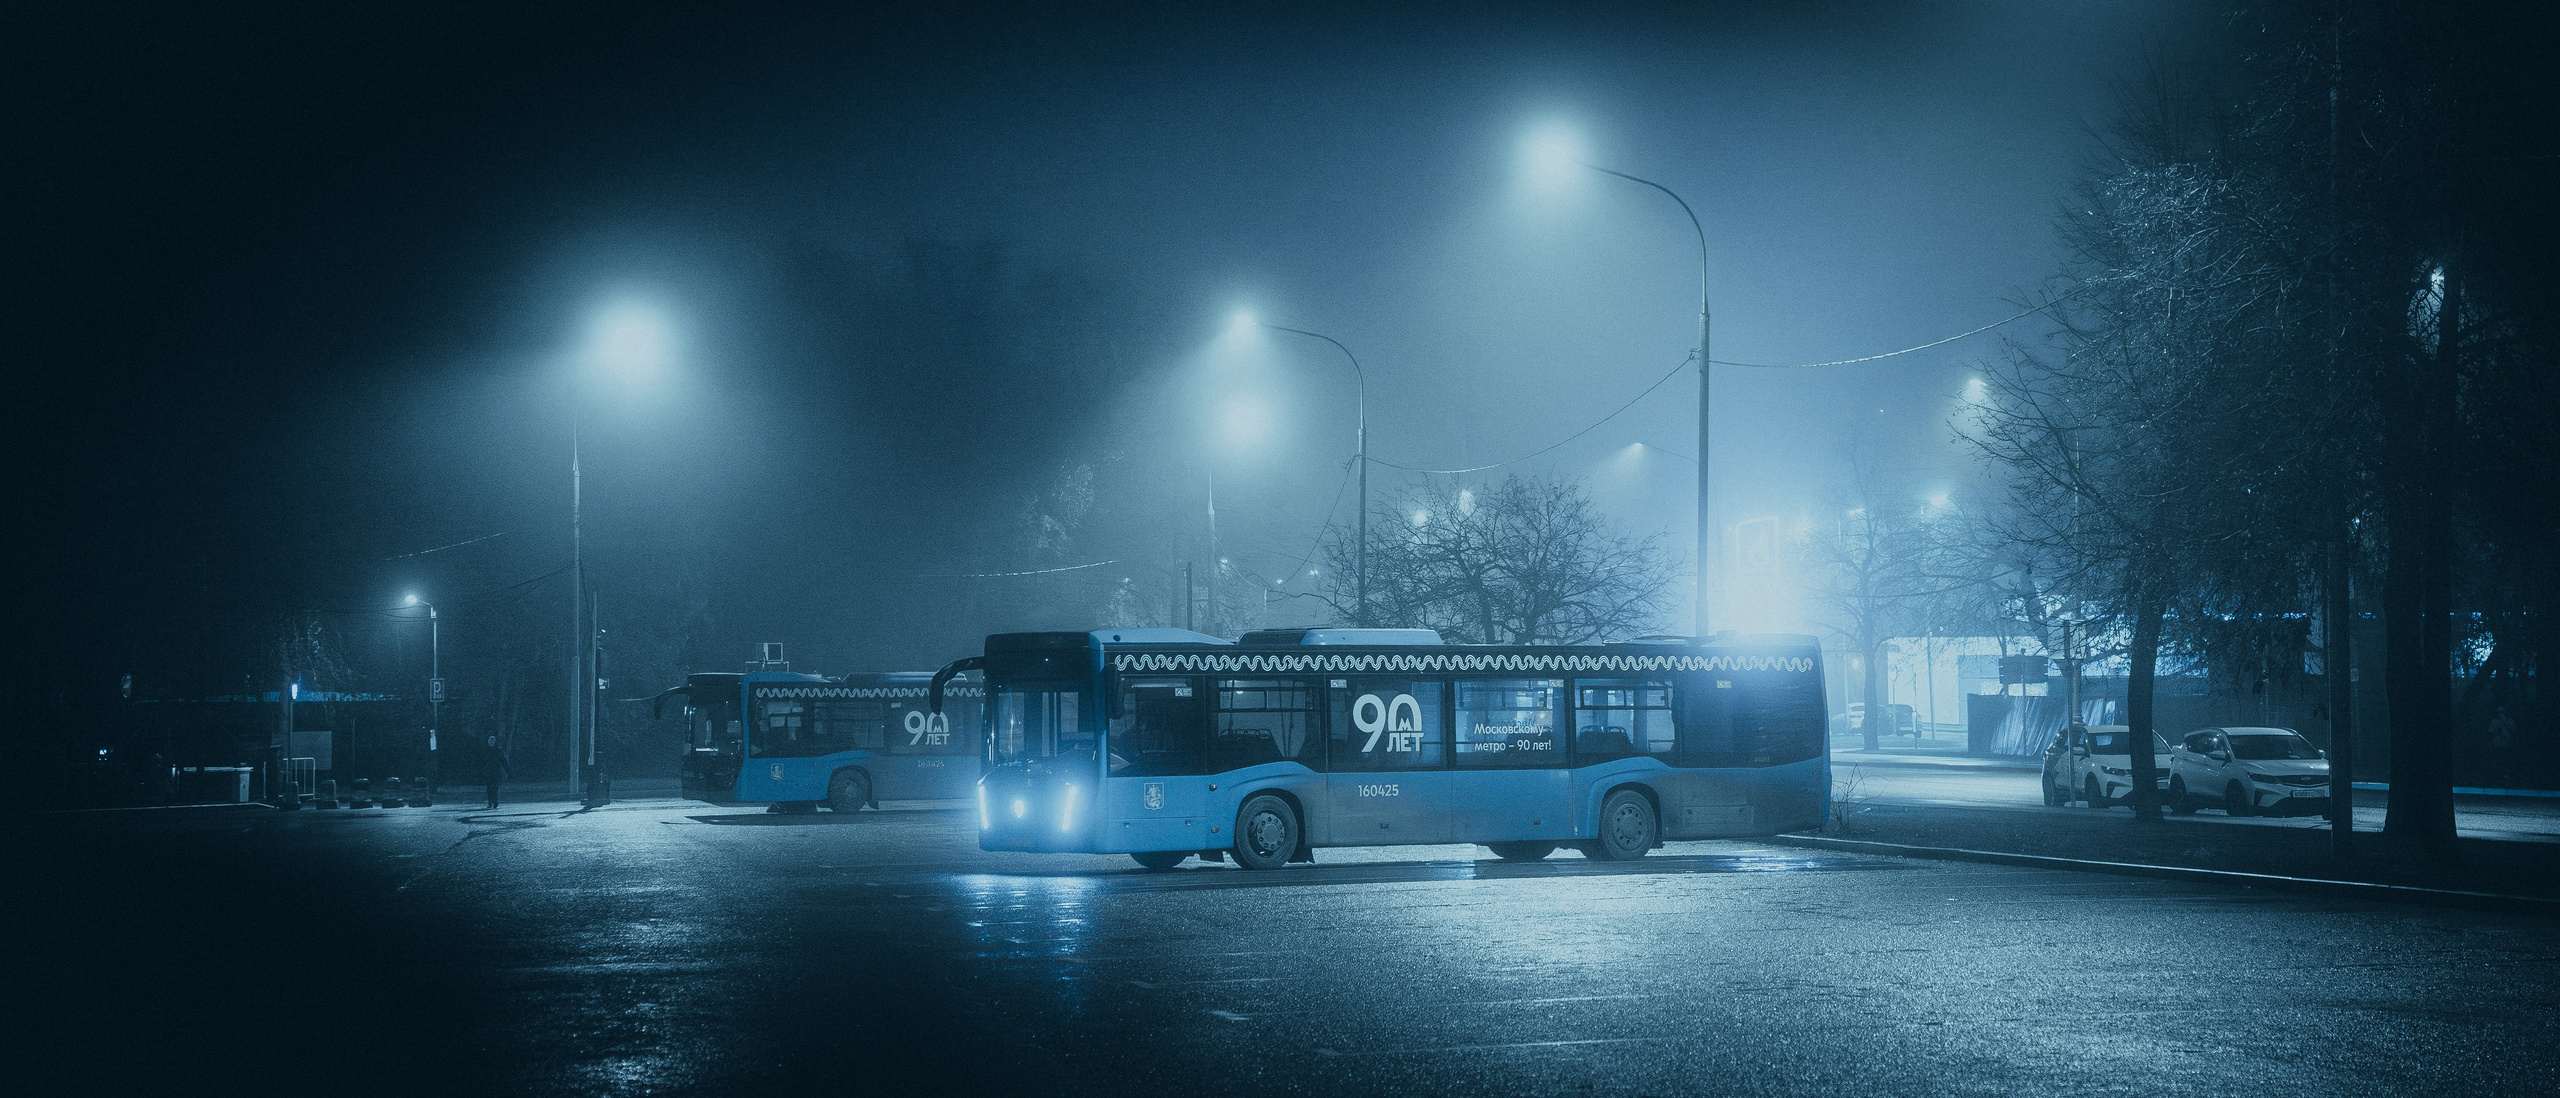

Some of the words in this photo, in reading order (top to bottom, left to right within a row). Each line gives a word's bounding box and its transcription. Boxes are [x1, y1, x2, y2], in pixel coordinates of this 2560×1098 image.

[904, 711, 949, 745] 90
[1353, 694, 1422, 753] 90
[1474, 723, 1544, 736] Московскому
[925, 734, 950, 745] ЛЕТ
[1386, 733, 1424, 752] ЛЕТ
[1475, 743, 1506, 753] метро
[1517, 740, 1530, 750] 90
[1532, 740, 1552, 750] лет!
[1358, 784, 1399, 797] 160425
